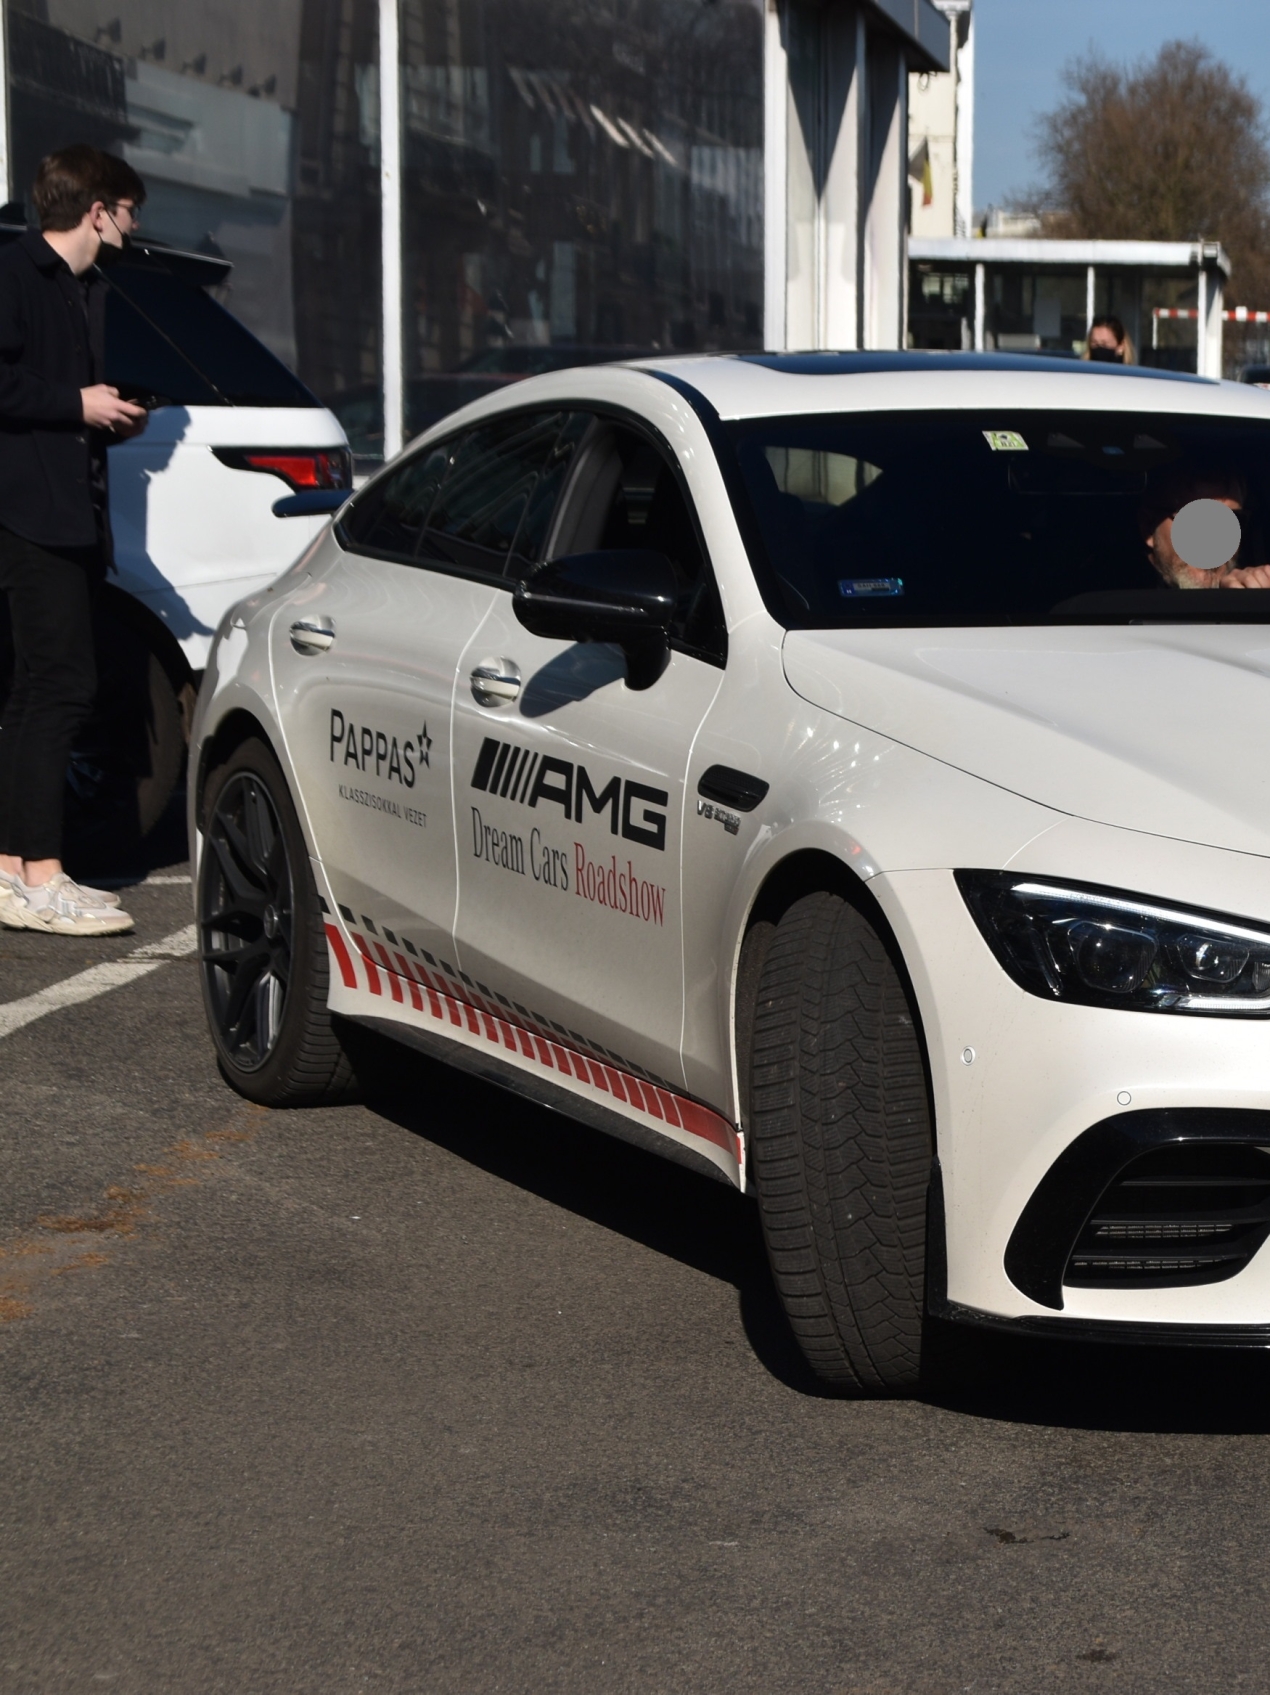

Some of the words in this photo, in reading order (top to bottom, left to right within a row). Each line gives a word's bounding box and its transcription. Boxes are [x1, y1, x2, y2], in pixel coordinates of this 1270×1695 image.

[329, 708, 415, 788] PAPPAS
[338, 783, 402, 819] KLASSZISOKKAL
[403, 806, 427, 828] VEZET
[527, 754, 669, 851] AMG
[471, 806, 526, 876] Dream
[530, 827, 569, 891] Cars
[573, 841, 666, 928] Roadshow
